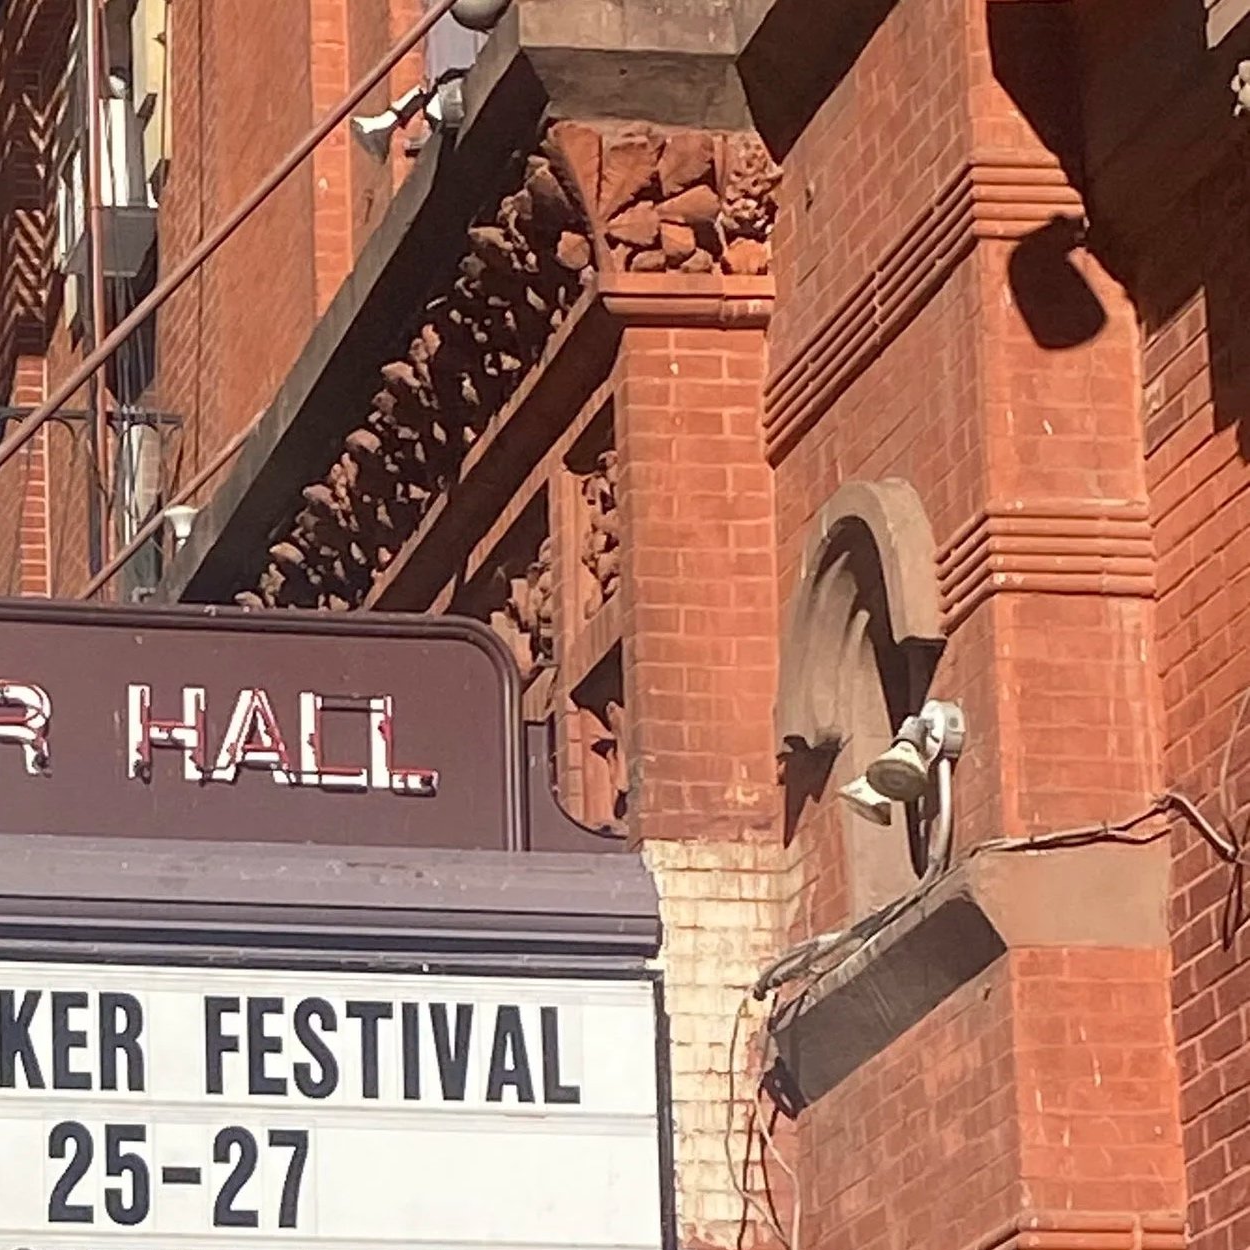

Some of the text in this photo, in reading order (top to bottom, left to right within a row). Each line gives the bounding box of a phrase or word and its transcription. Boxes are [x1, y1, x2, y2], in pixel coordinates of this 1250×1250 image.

[126, 683, 439, 797] HALL
[204, 995, 581, 1105] FESTIVAL
[48, 1120, 310, 1229] 25-27
